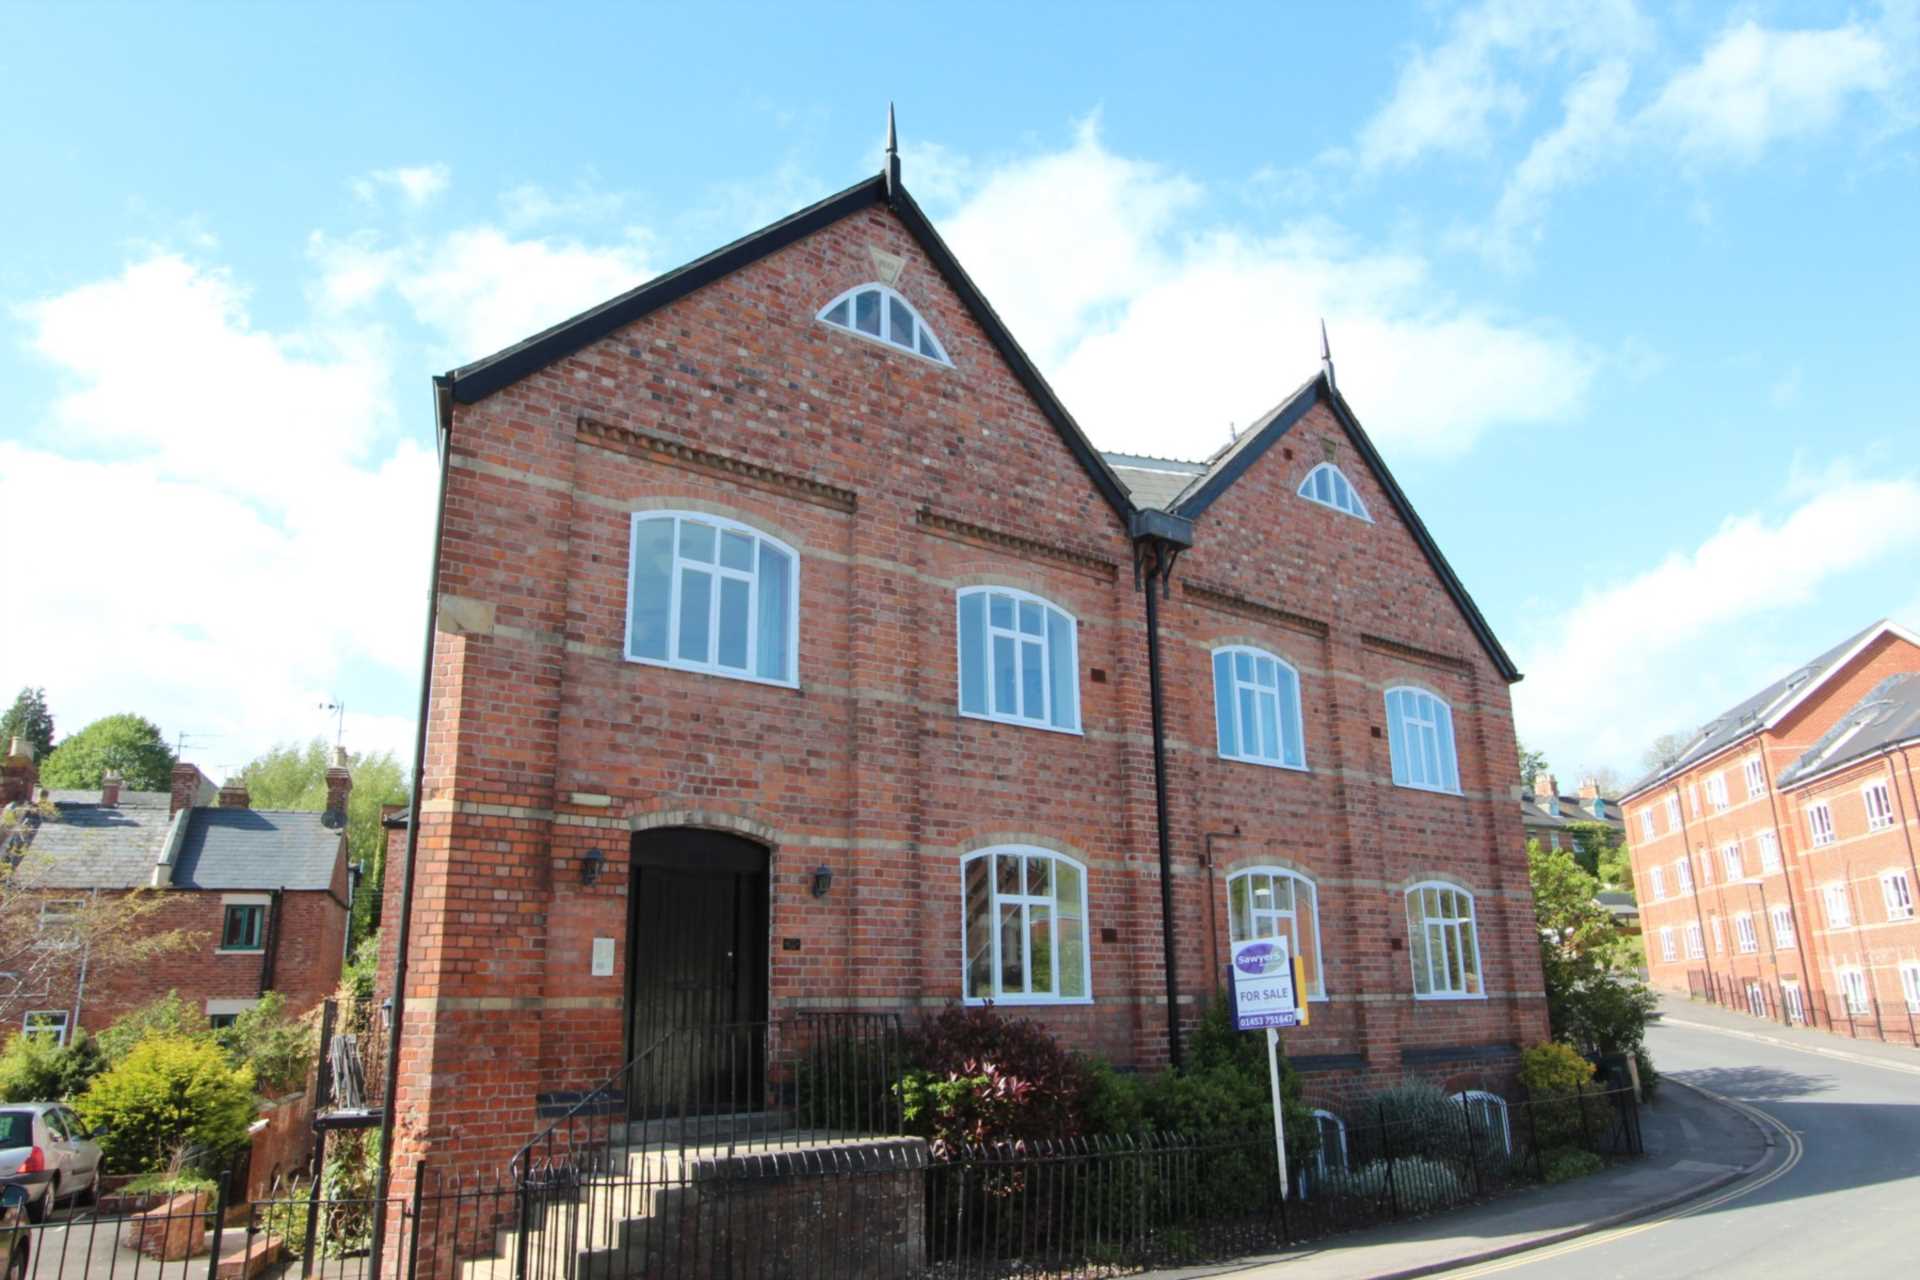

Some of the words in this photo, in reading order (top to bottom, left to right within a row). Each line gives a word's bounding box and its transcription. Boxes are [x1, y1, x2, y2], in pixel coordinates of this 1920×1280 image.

[1240, 990, 1260, 1001] FOR
[1263, 988, 1288, 999] SALE
[1240, 1017, 1264, 1026] 01453
